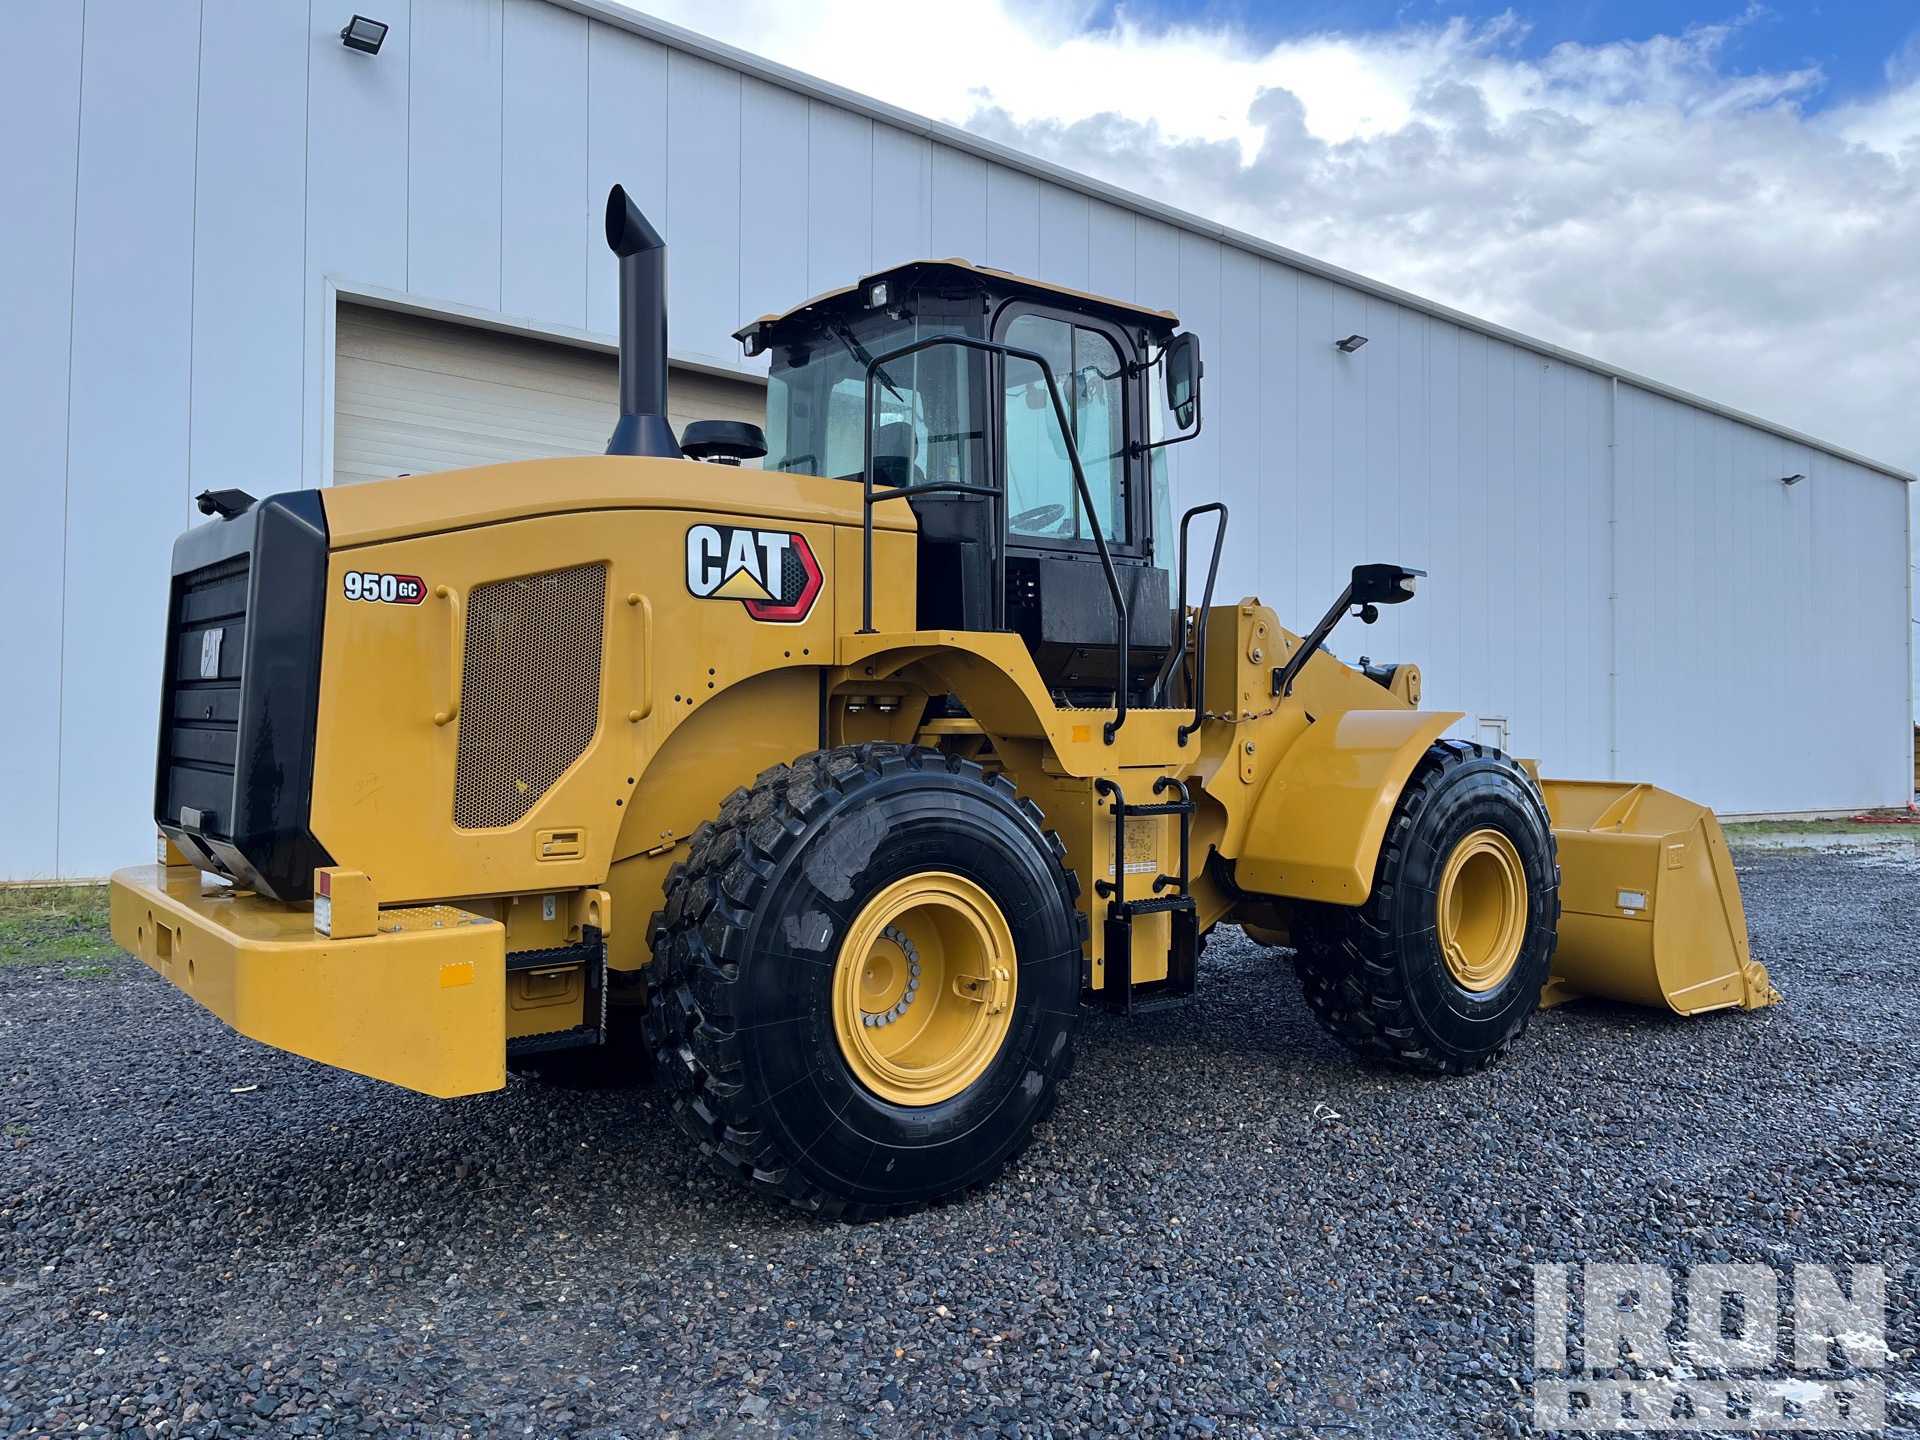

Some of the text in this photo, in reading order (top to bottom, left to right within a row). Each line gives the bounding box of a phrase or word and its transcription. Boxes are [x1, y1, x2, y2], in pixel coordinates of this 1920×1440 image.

[345, 572, 418, 602] 950 GC
[687, 525, 790, 600] CAT
[200, 627, 224, 680] CAT
[904, 996, 1042, 1139] TRIANGLE
